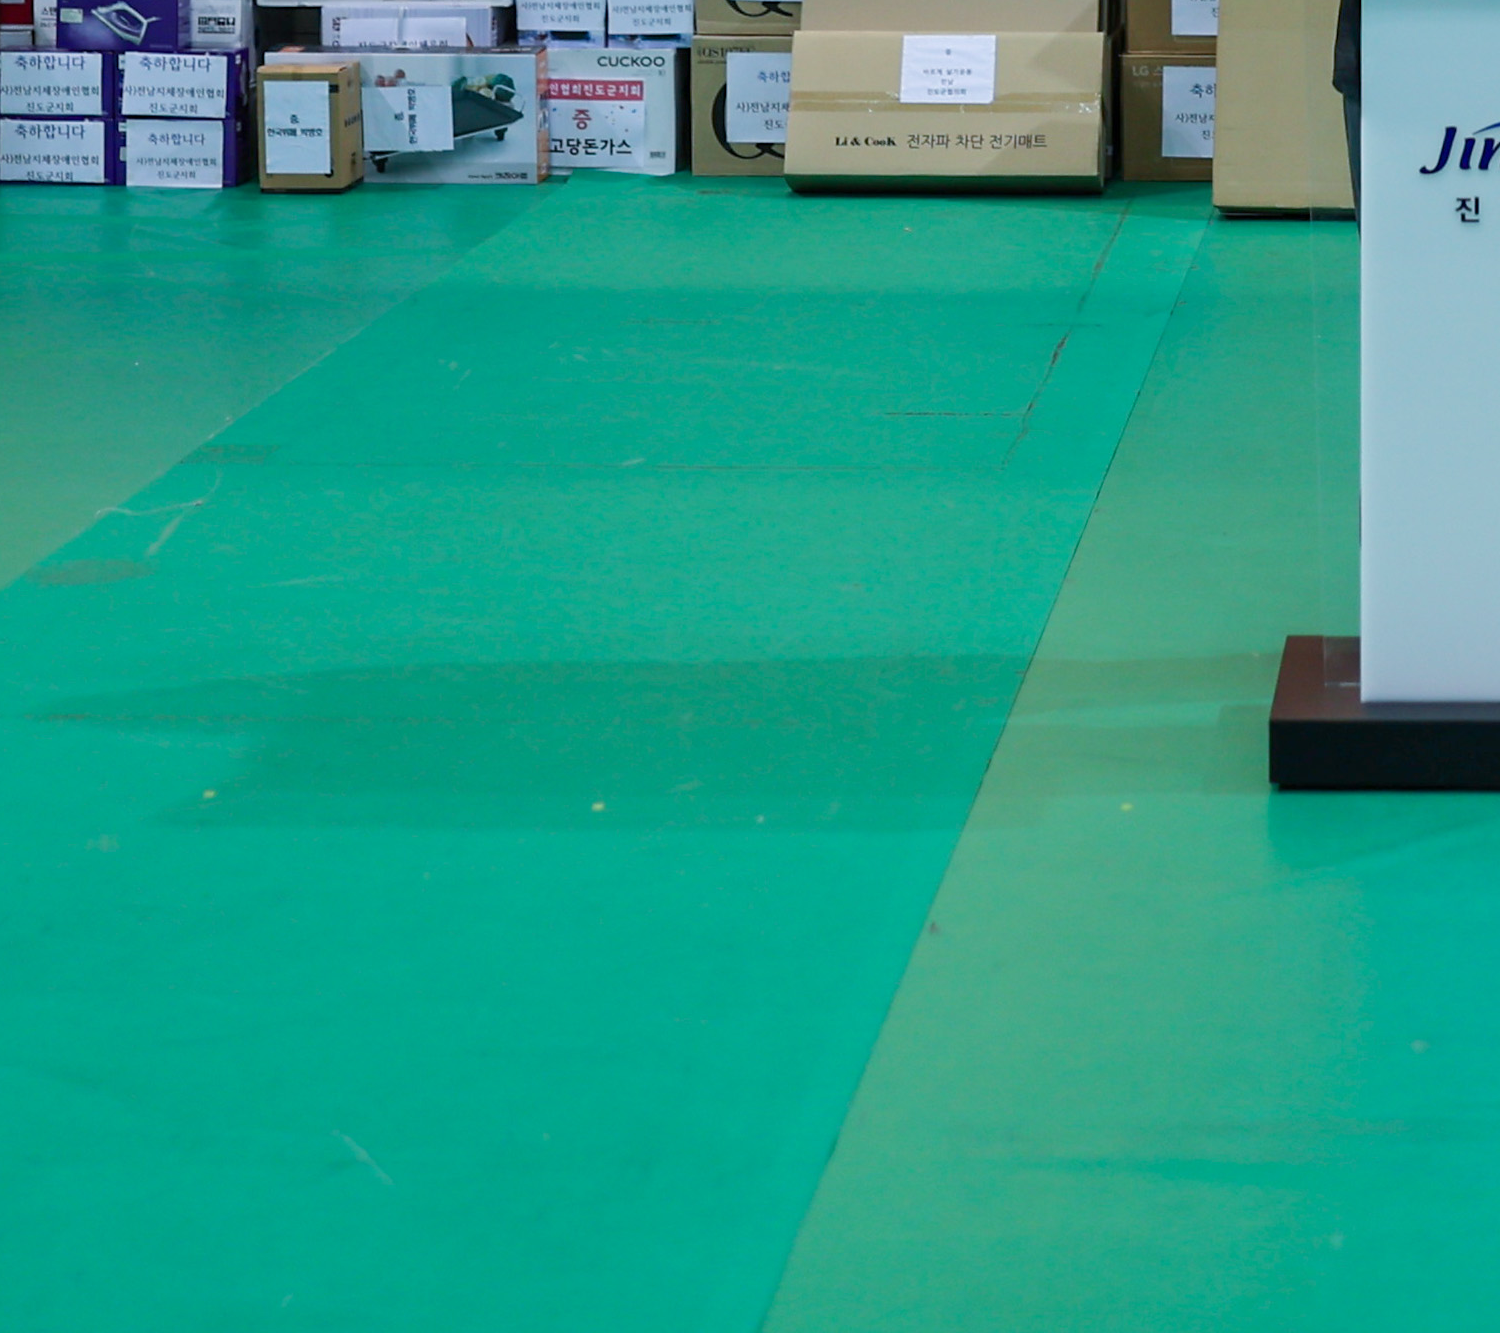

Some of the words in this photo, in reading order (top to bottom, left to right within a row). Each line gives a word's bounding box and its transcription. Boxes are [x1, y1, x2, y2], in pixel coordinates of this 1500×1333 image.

[14, 55, 86, 71] 축하합니다
[139, 55, 212, 73] 축하합니다
[597, 55, 666, 68] CUCKOO
[572, 108, 593, 131] 증
[14, 124, 86, 140] 축하합니다
[147, 133, 205, 147] 축하합니다
[834, 136, 848, 147] Li
[849, 136, 863, 147] &
[906, 133, 950, 150] 전자파
[954, 134, 985, 150] 차단
[988, 133, 1048, 150] 전기매트
